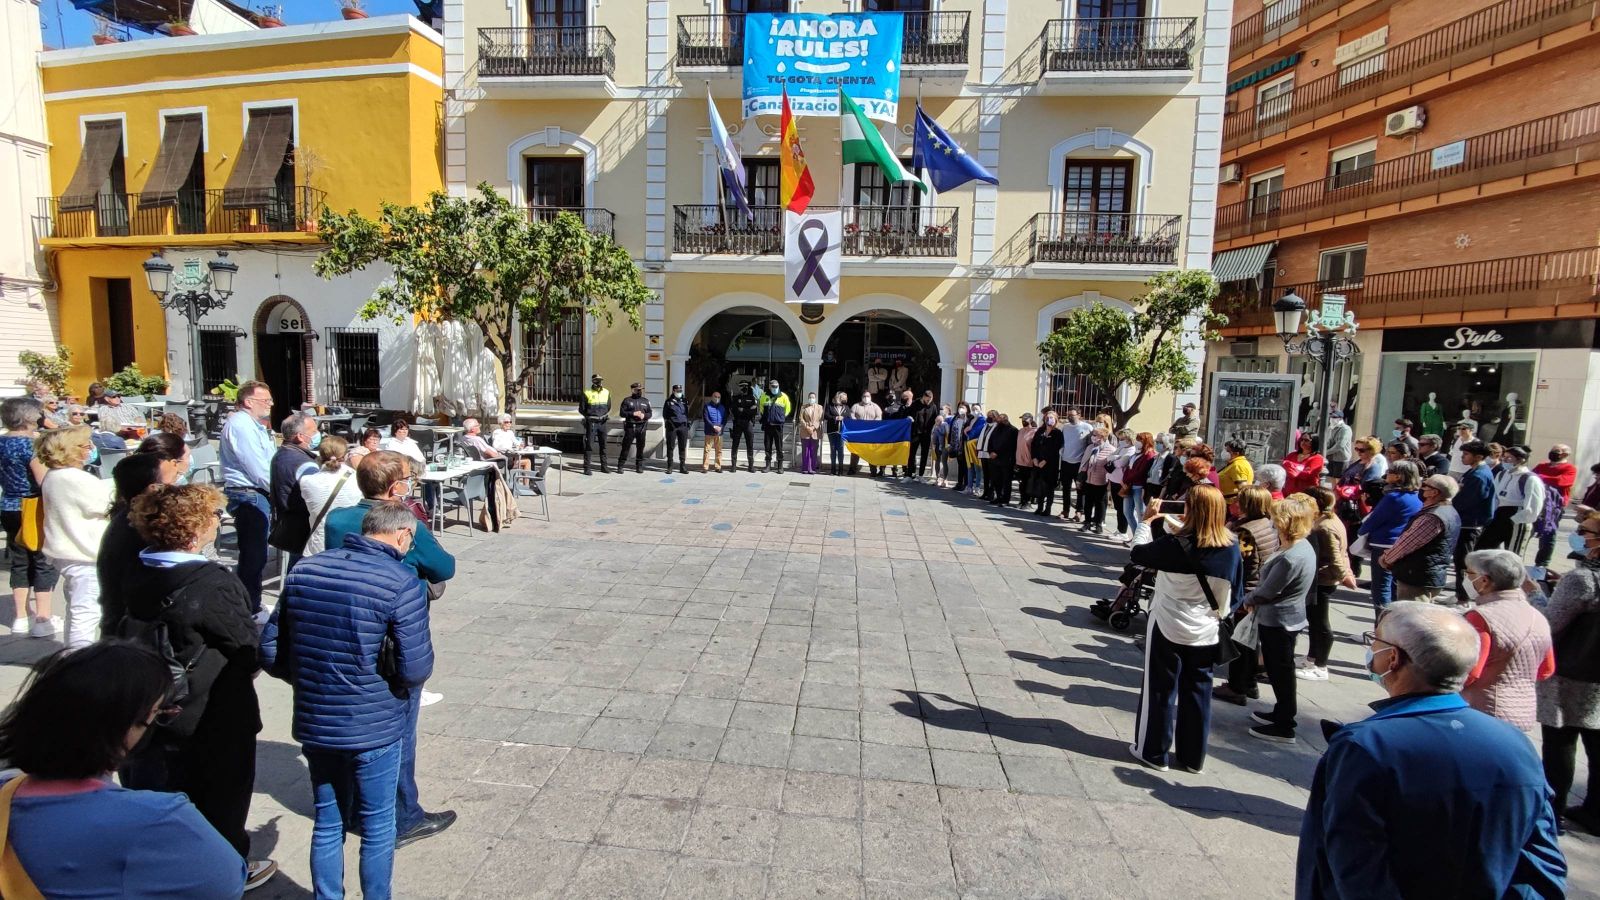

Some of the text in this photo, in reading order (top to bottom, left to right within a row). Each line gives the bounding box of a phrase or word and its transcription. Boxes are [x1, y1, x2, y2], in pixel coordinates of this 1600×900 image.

[769, 18, 878, 39] ¡AHORA
[776, 39, 869, 58] RULES!
[767, 75, 876, 85] TU GOTA CUENTA
[869, 101, 895, 118] YA!
[1443, 326, 1504, 349] Style
[971, 352, 994, 360] STOP
